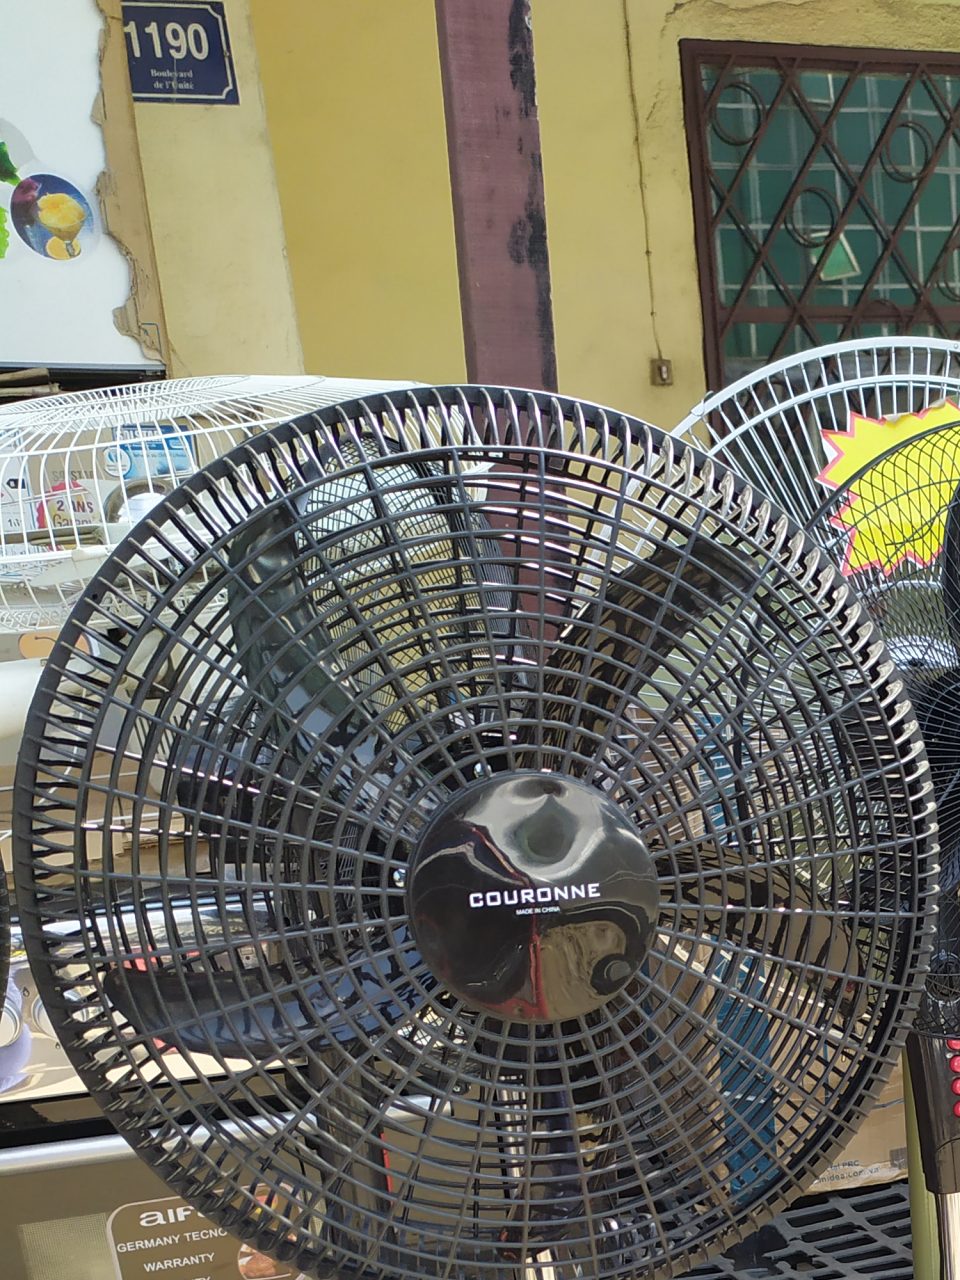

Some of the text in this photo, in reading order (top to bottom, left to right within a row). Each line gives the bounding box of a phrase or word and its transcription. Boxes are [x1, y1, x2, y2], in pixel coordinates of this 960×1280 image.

[123, 20, 209, 60] 1190
[469, 883, 601, 909] COURONNE
[116, 1233, 181, 1253] GERMANY
[143, 1252, 215, 1273] WARRANTY
